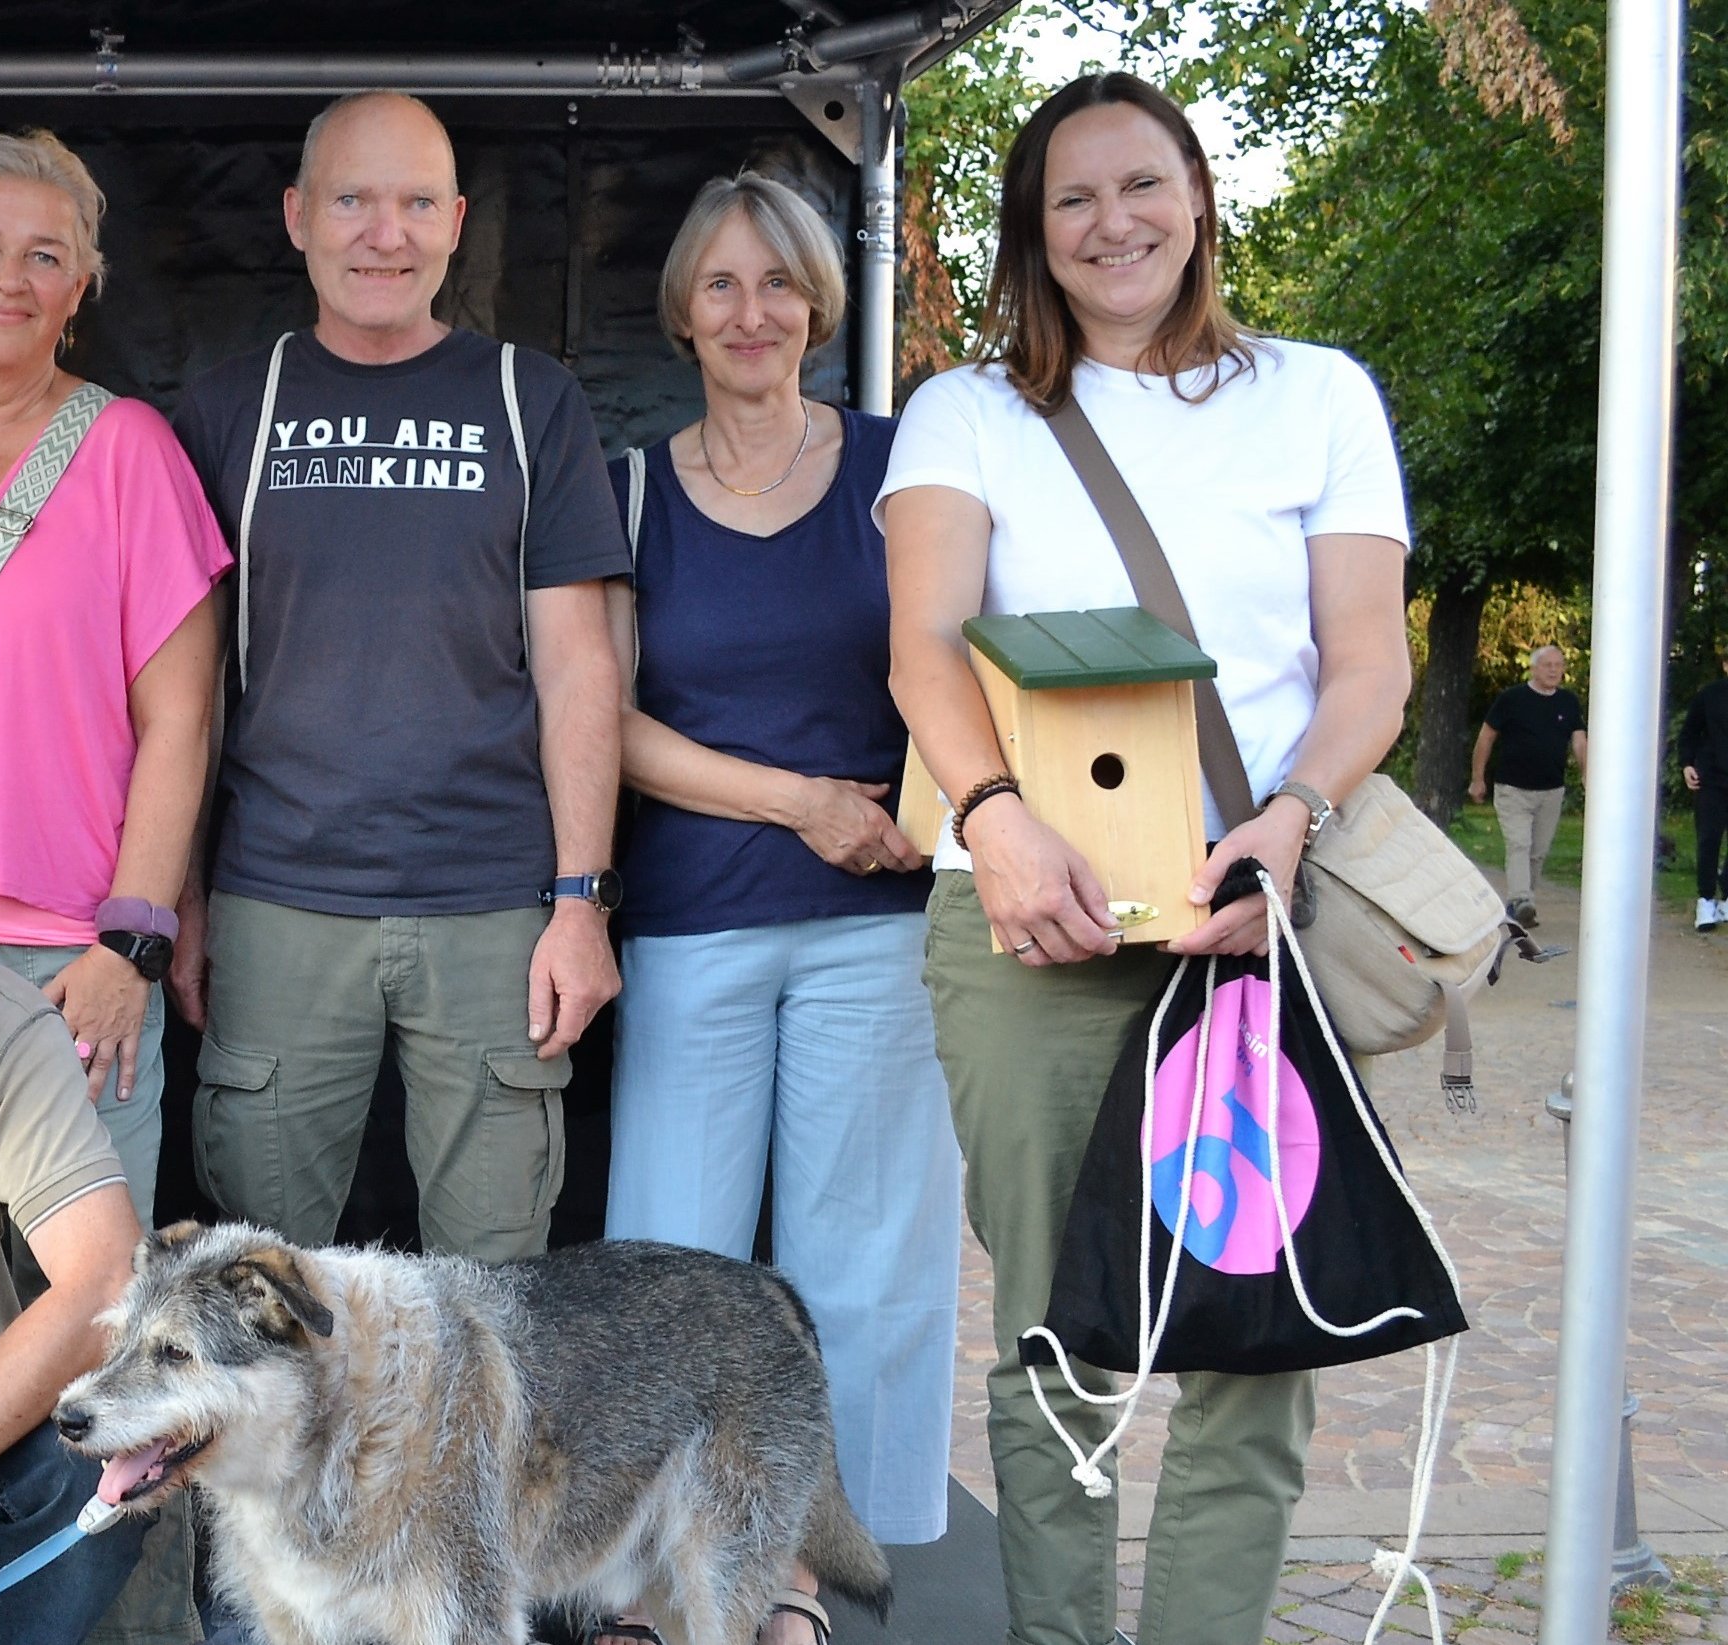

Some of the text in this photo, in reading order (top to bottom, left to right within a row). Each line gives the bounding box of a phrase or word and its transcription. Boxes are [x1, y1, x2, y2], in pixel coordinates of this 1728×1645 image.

[274, 416, 485, 451] YOU ARE
[270, 456, 485, 490] MANKIND
